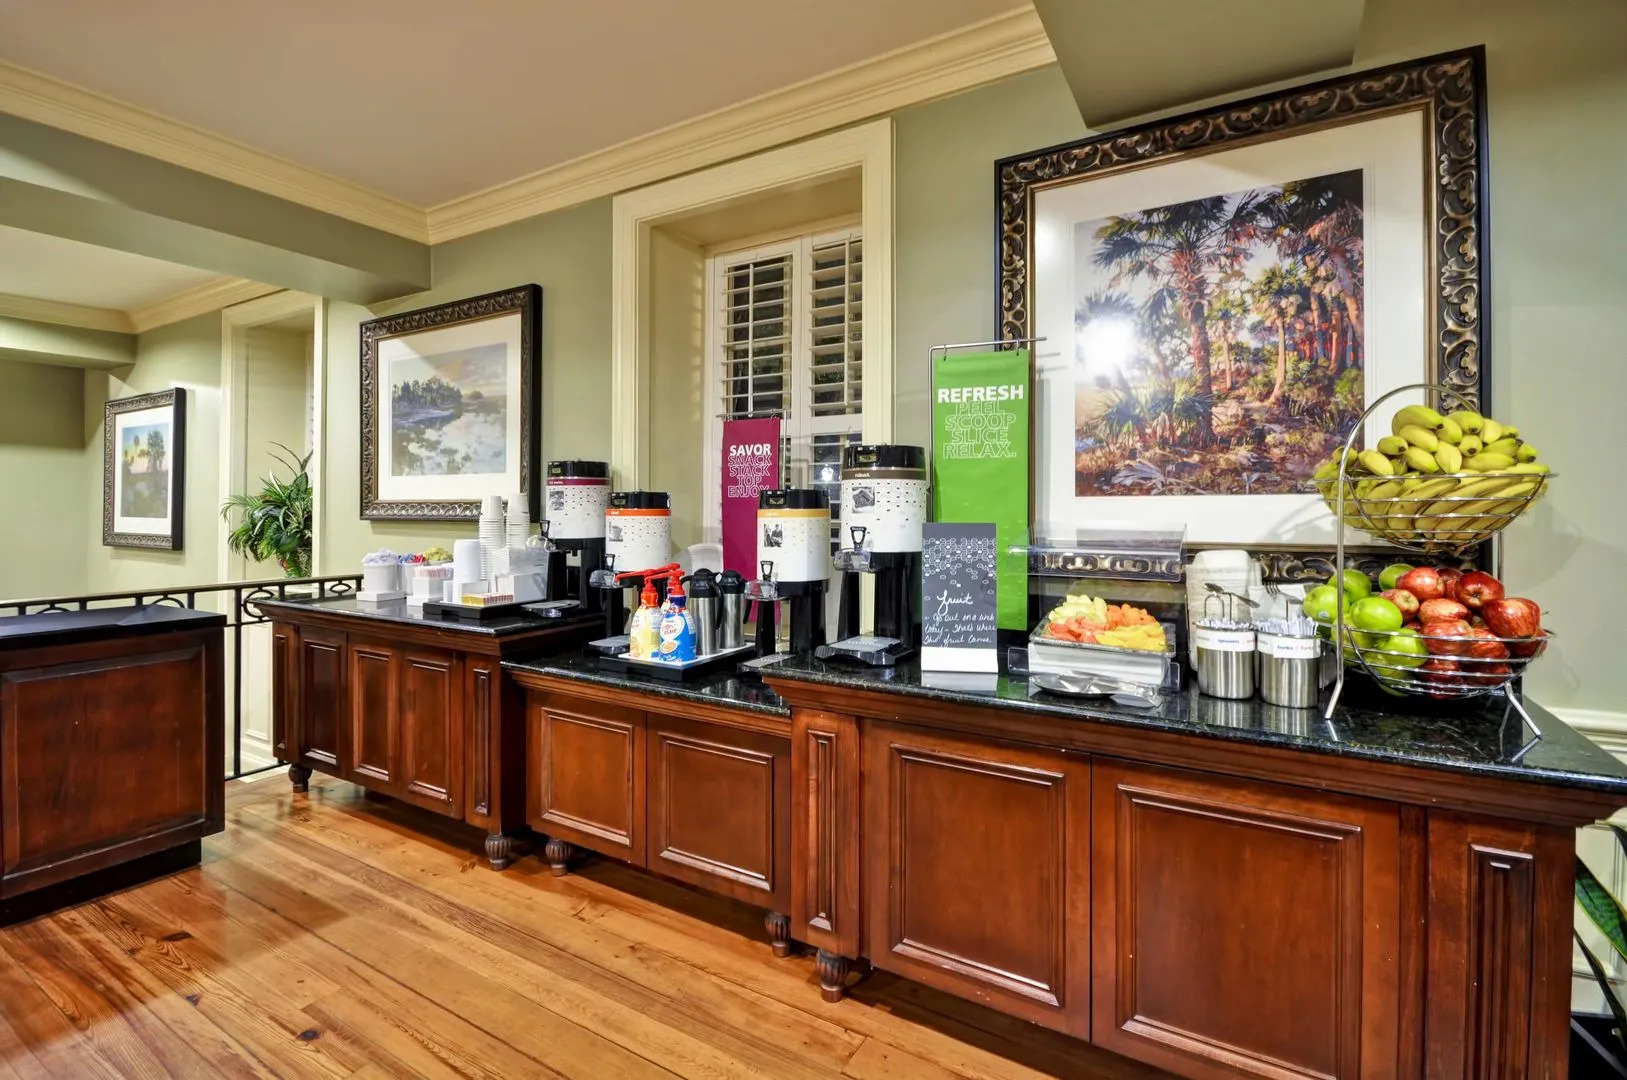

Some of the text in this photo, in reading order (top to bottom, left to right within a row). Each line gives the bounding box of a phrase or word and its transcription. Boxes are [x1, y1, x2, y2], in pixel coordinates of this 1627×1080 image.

[938, 384, 1024, 403] REFRESH
[956, 400, 1005, 415] PEEL
[944, 413, 1016, 431] SCOOP
[952, 428, 1009, 444] SLICE
[729, 444, 771, 456] SAVOR
[728, 454, 772, 466] SNACK
[729, 465, 770, 477] STACK
[737, 475, 762, 487] TOP
